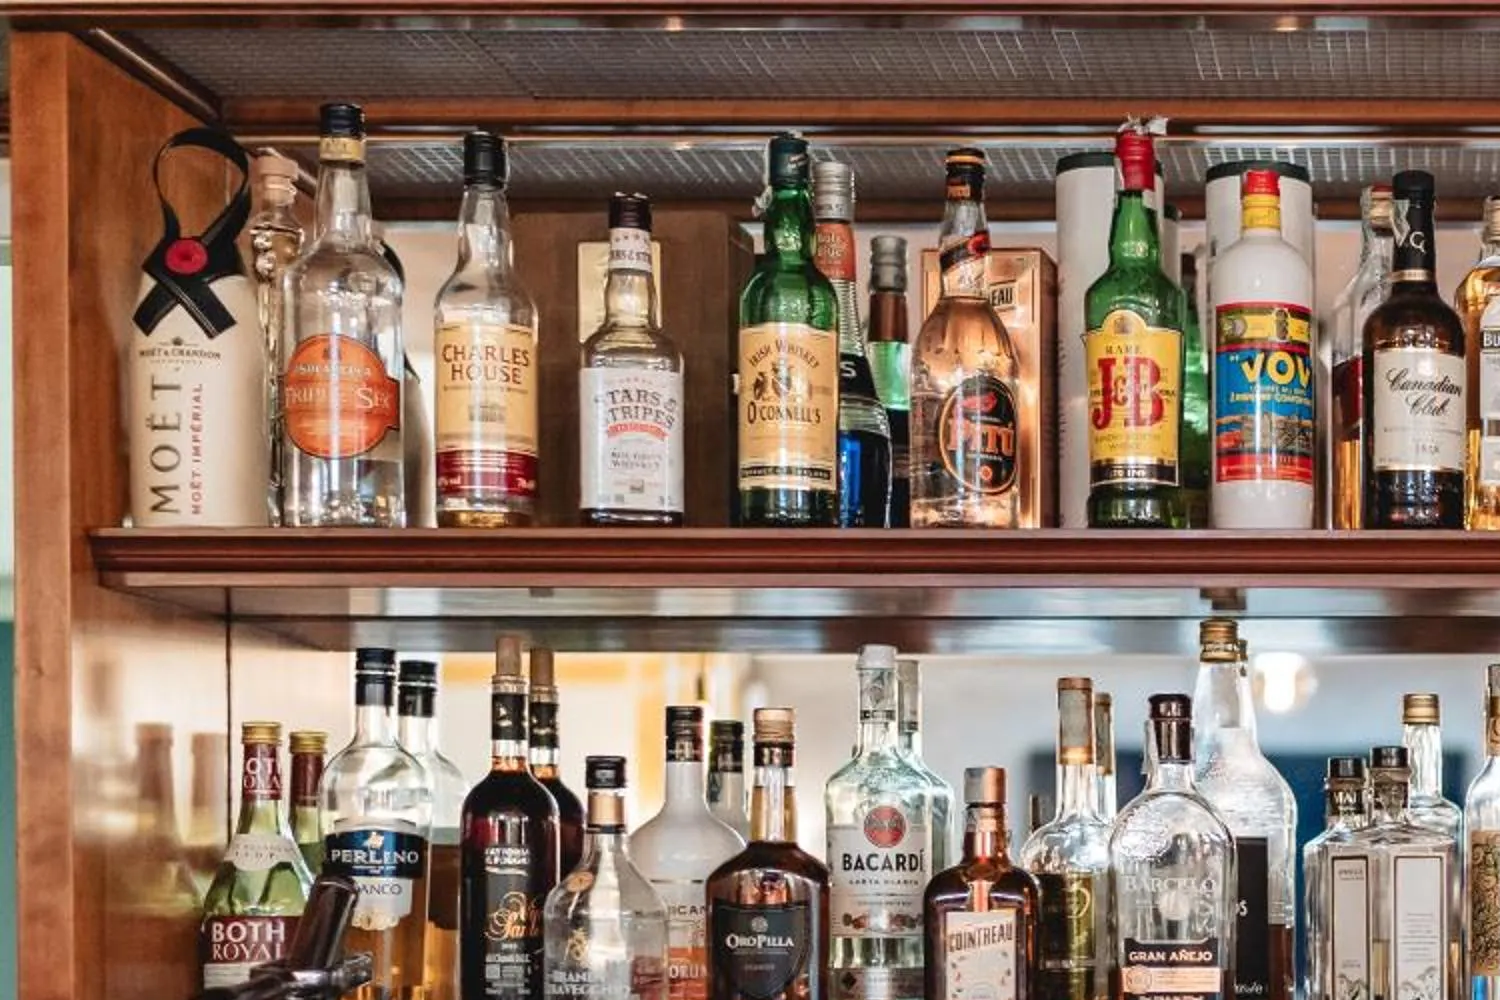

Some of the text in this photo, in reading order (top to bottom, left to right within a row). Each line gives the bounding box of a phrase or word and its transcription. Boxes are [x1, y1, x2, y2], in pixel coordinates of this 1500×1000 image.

[442, 343, 529, 368] CHARLES
[450, 366, 522, 385] HOUSE
[1241, 350, 1312, 390] VOV
[1386, 366, 1462, 397] Canadian
[1405, 391, 1451, 416] Club
[146, 375, 182, 514] MOËT
[842, 849, 925, 872] BACARDÍ
[357, 883, 403, 895] ANCO
[211, 921, 285, 943] BOTH
[949, 919, 1013, 954] COINTREAU
[1129, 949, 1213, 962] GRAN AÑEJO
